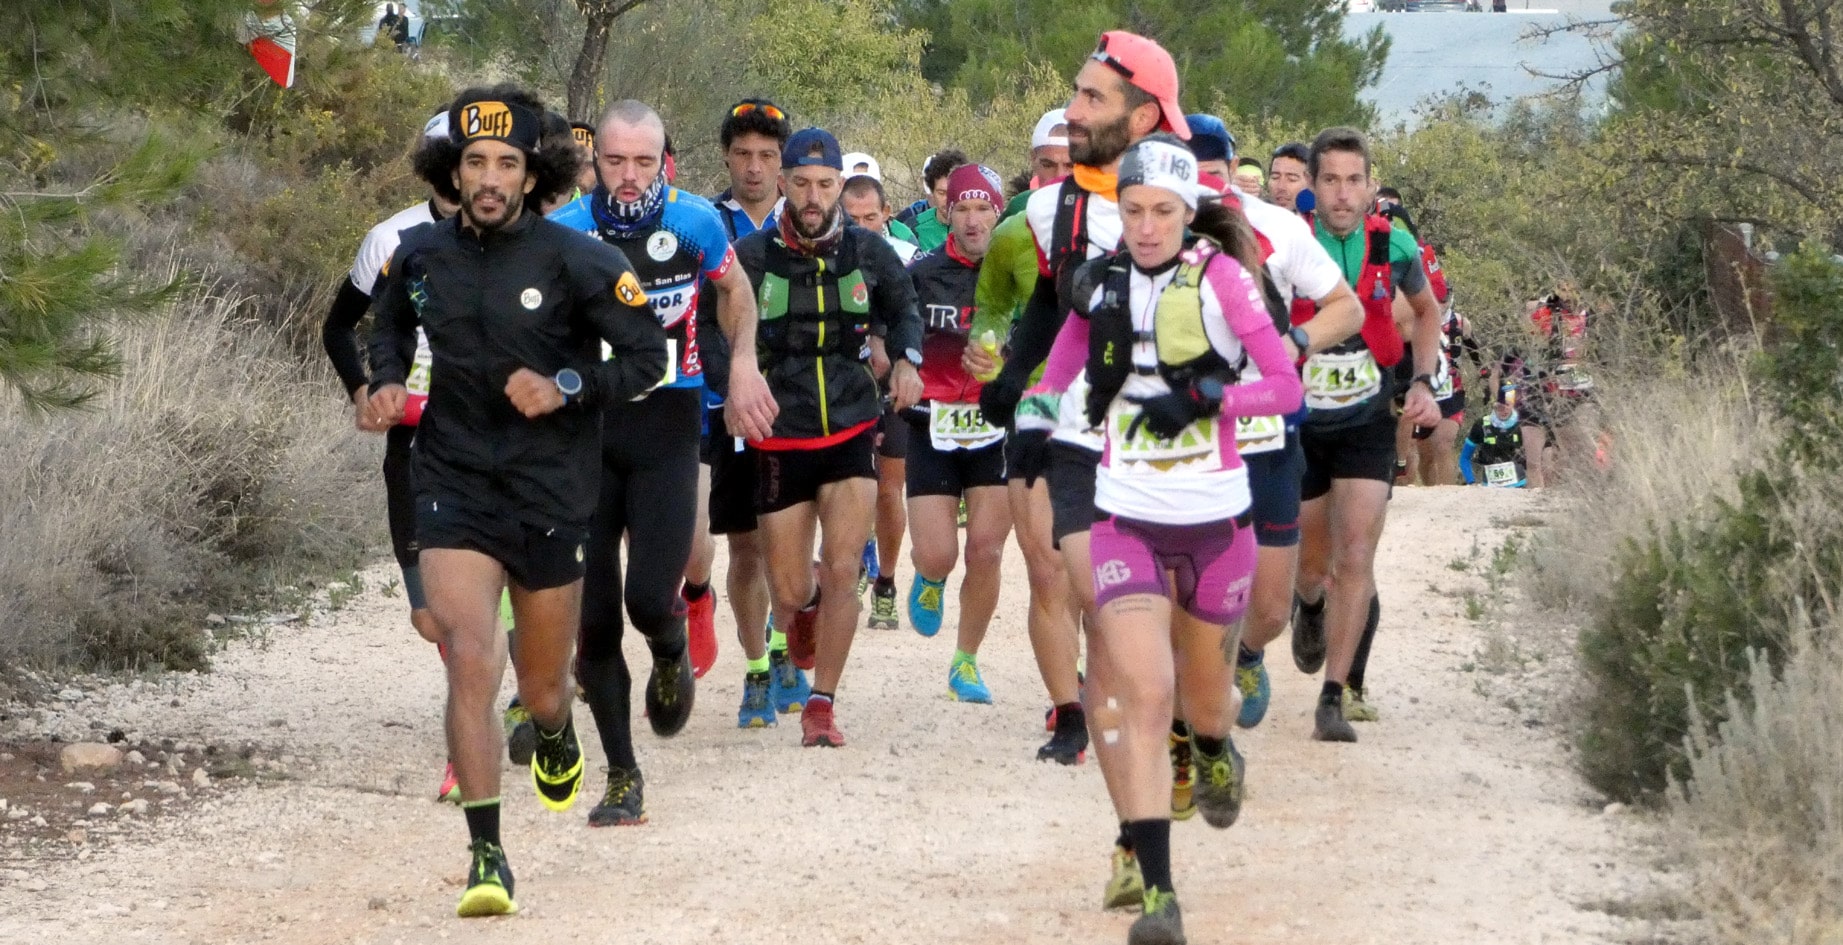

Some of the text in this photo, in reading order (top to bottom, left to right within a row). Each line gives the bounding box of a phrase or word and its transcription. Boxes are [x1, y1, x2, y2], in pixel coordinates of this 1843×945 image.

[655, 277, 673, 286] San
[674, 272, 692, 282] Blas
[1330, 367, 1357, 385] 14
[950, 409, 987, 427] 115
